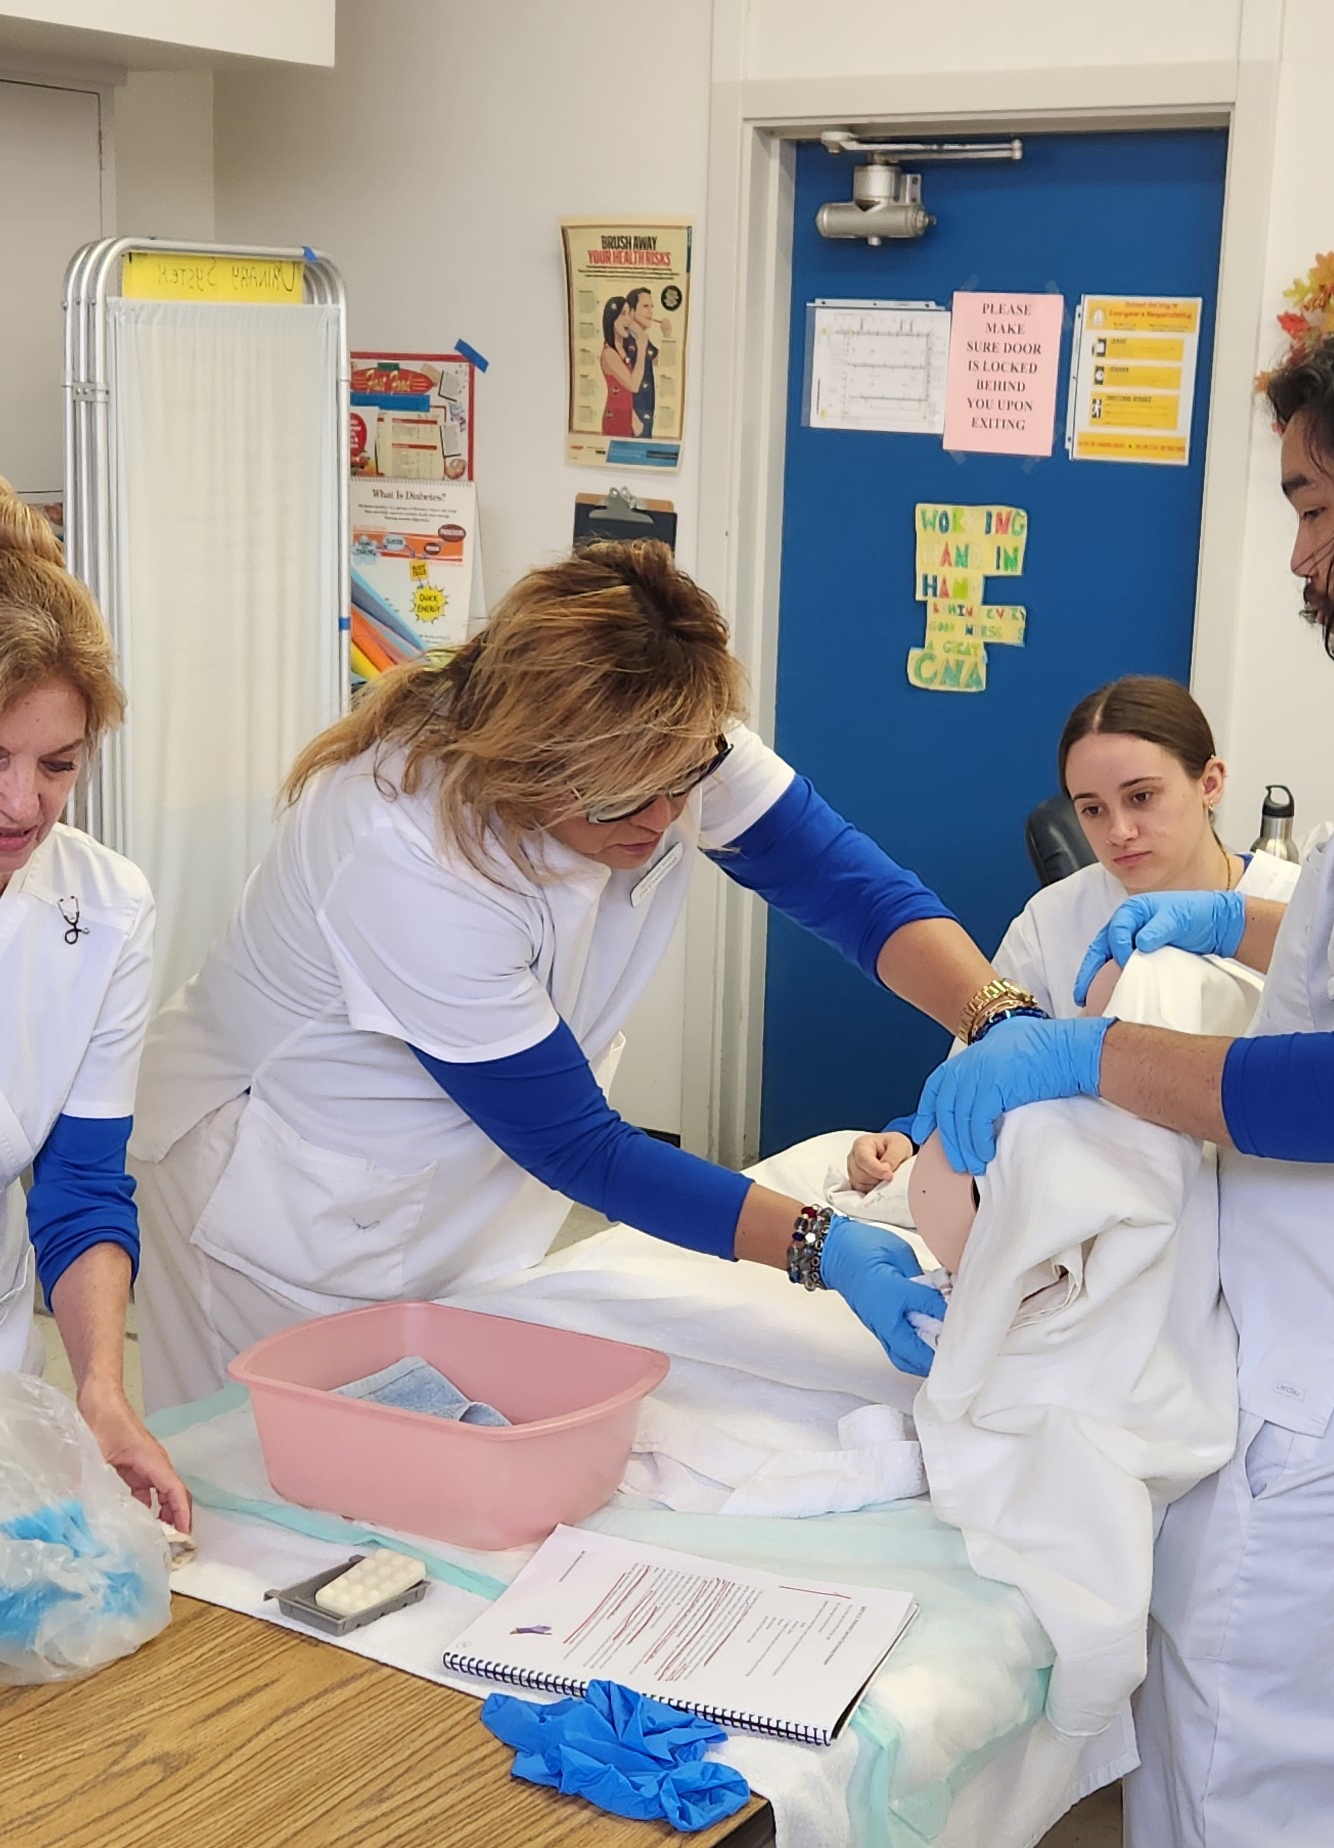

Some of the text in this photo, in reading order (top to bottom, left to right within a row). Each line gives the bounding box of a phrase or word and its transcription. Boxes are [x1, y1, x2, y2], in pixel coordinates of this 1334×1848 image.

[601, 235, 657, 250] BRUSH AWAY
[588, 250, 671, 266] YOUR HEALTH RISKS
[982, 303, 1032, 316] PLEASE
[985, 322, 1025, 335] MAKE
[967, 341, 1042, 355] SURE DOOR
[968, 360, 1038, 374] IS LOCKED
[976, 380, 1026, 392] BEHIND
[967, 398, 1033, 412] YOU UPON
[971, 417, 1025, 431] EXITING
[372, 488, 393, 499] What
[920, 508, 1025, 537] WORING
[996, 545, 1019, 571] IN
[417, 605, 440, 613] ENERGY
[913, 652, 984, 689] CNA
